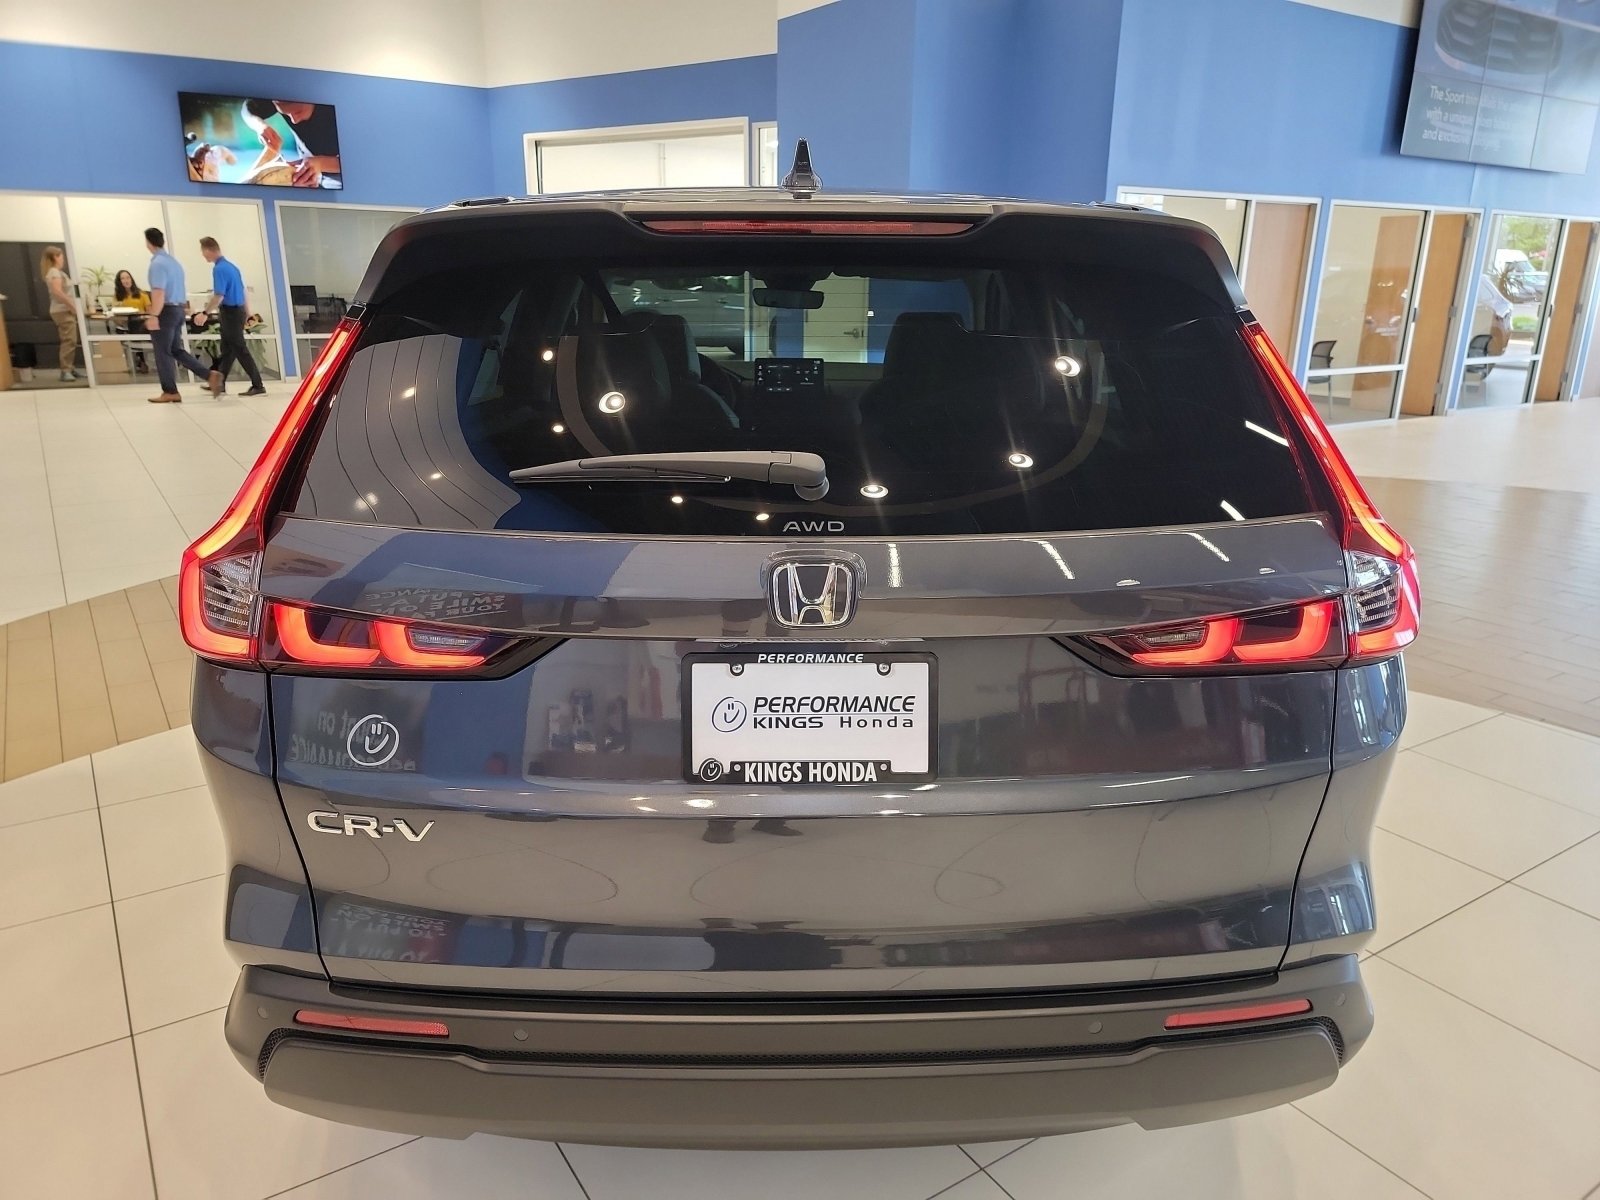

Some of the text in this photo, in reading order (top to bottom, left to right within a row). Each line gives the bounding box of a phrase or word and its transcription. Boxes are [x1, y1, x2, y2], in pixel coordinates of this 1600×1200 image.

[1430, 85, 1444, 101] The
[1445, 88, 1465, 105] Sport
[1422, 128, 1438, 140] and
[782, 520, 845, 533] AWD
[757, 653, 864, 664] PERFORMANCE
[753, 695, 916, 713] PERFORMANCE
[753, 716, 914, 729] KINGS Honda
[744, 761, 878, 783] KINGS HONDA
[307, 810, 435, 843] CR-V
